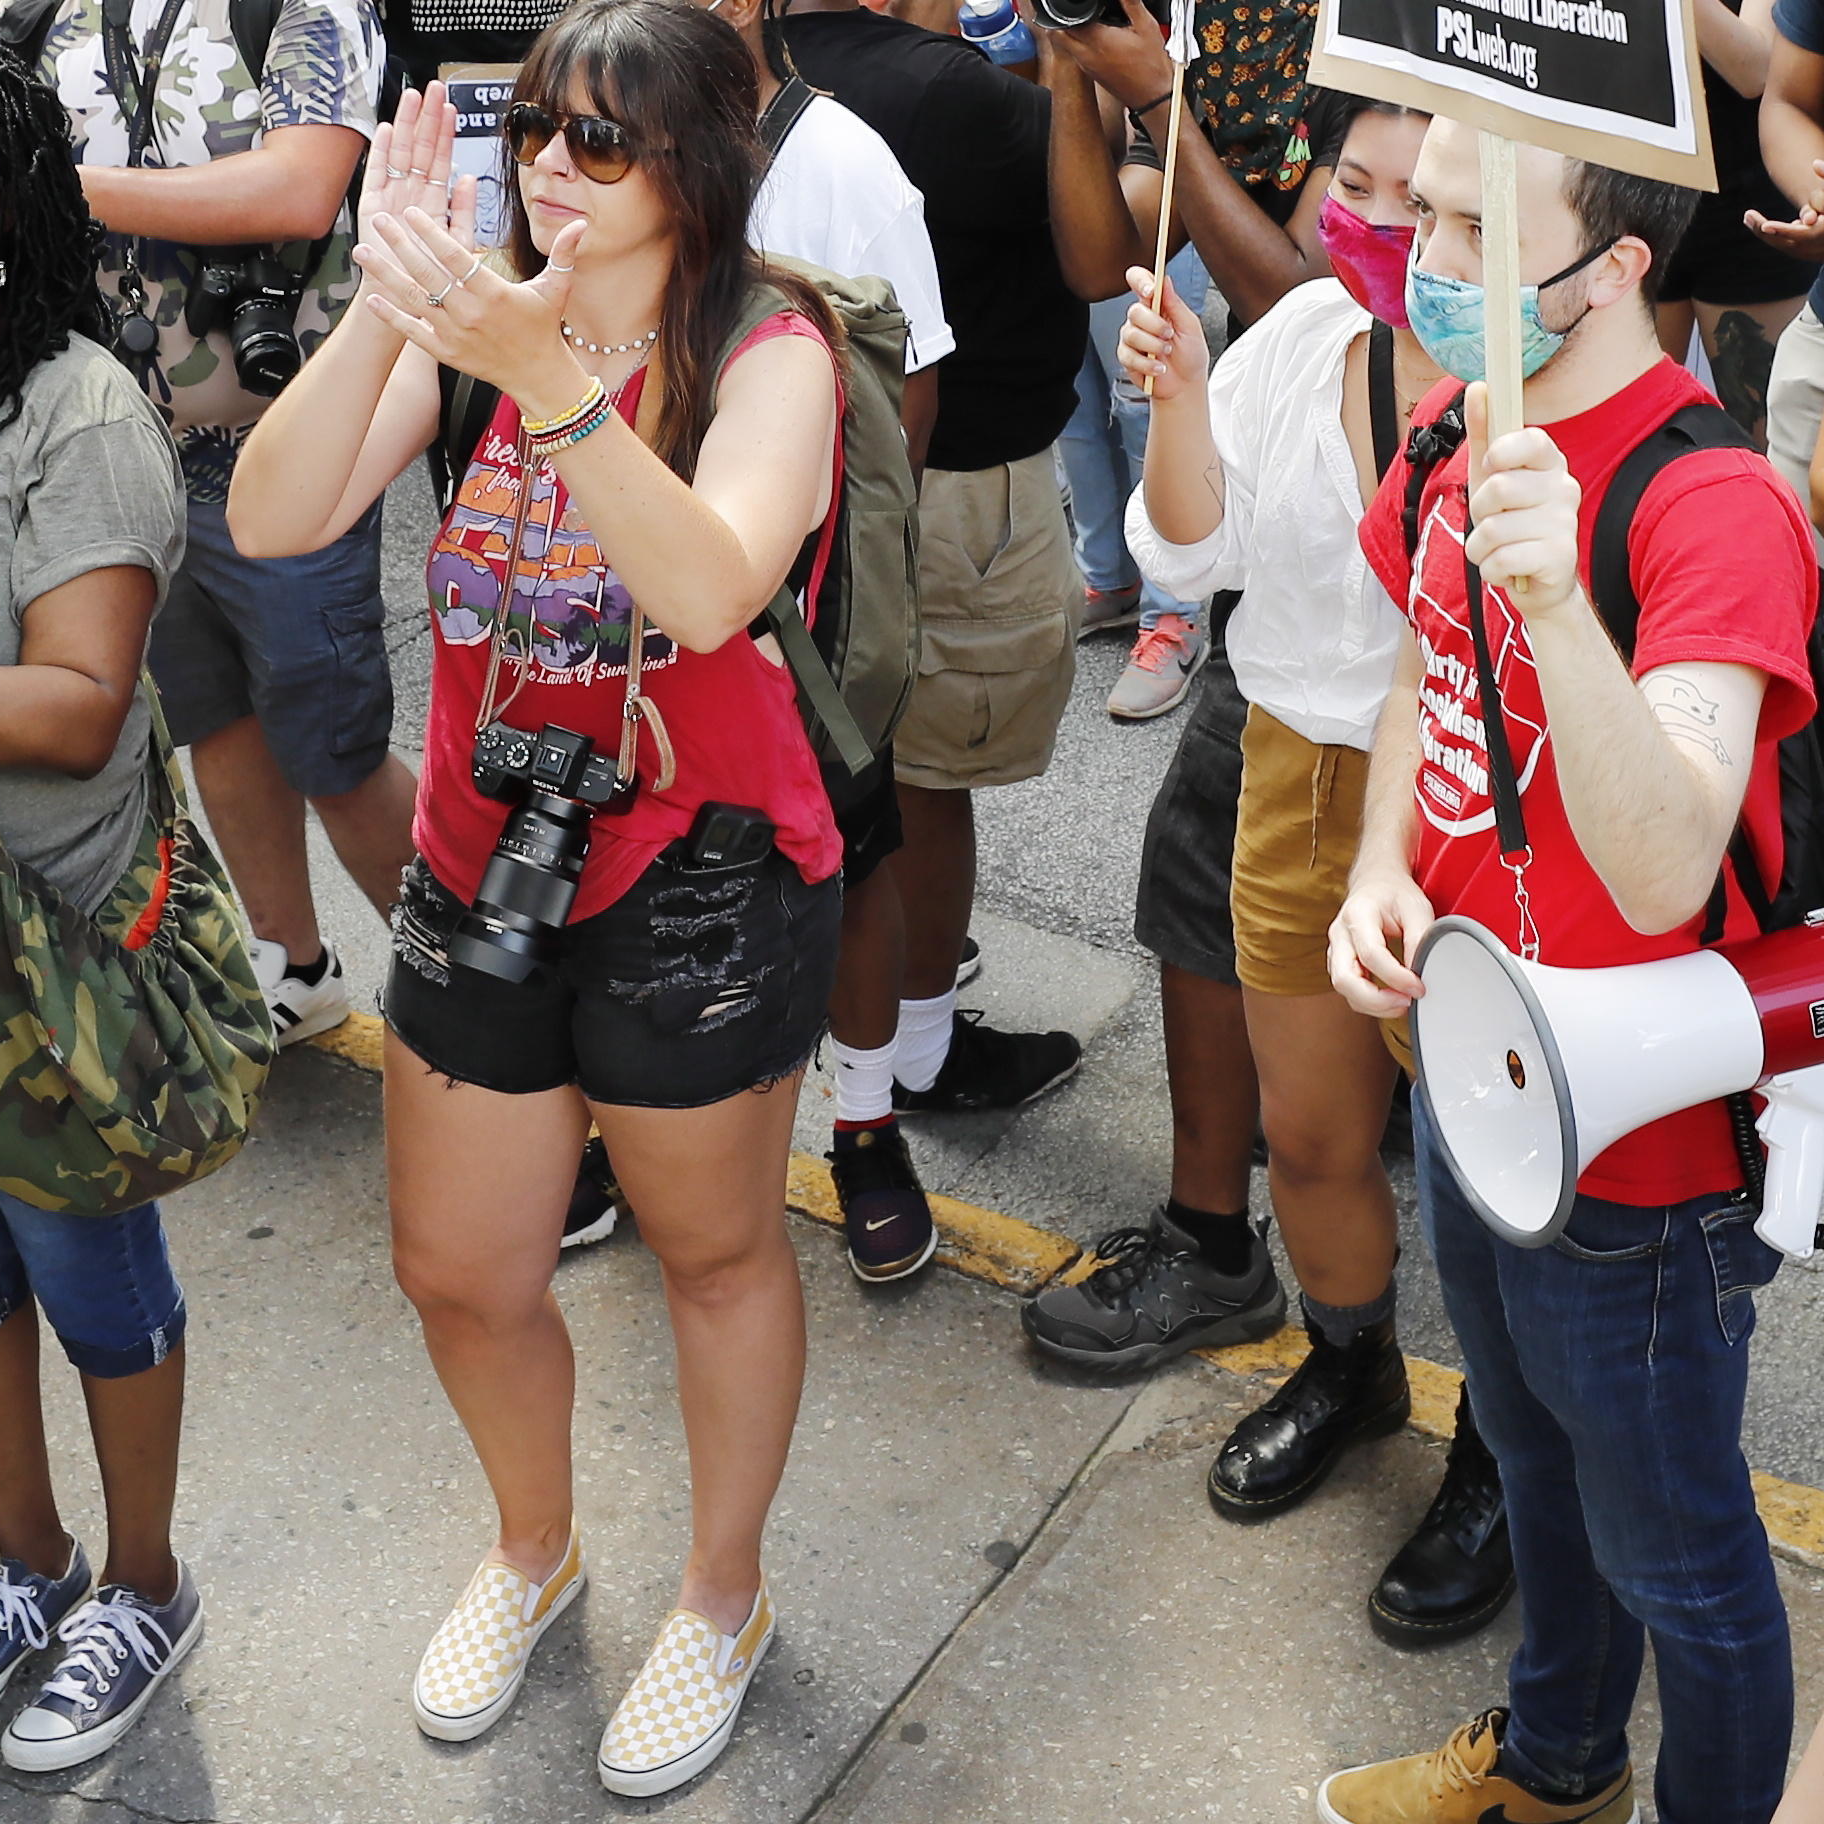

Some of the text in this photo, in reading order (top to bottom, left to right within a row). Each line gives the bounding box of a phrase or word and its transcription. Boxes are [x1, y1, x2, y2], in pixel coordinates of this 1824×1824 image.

[1435, 6, 1539, 90] PSLweb.org
[486, 465, 523, 497] fro
[537, 664, 574, 686] Land
